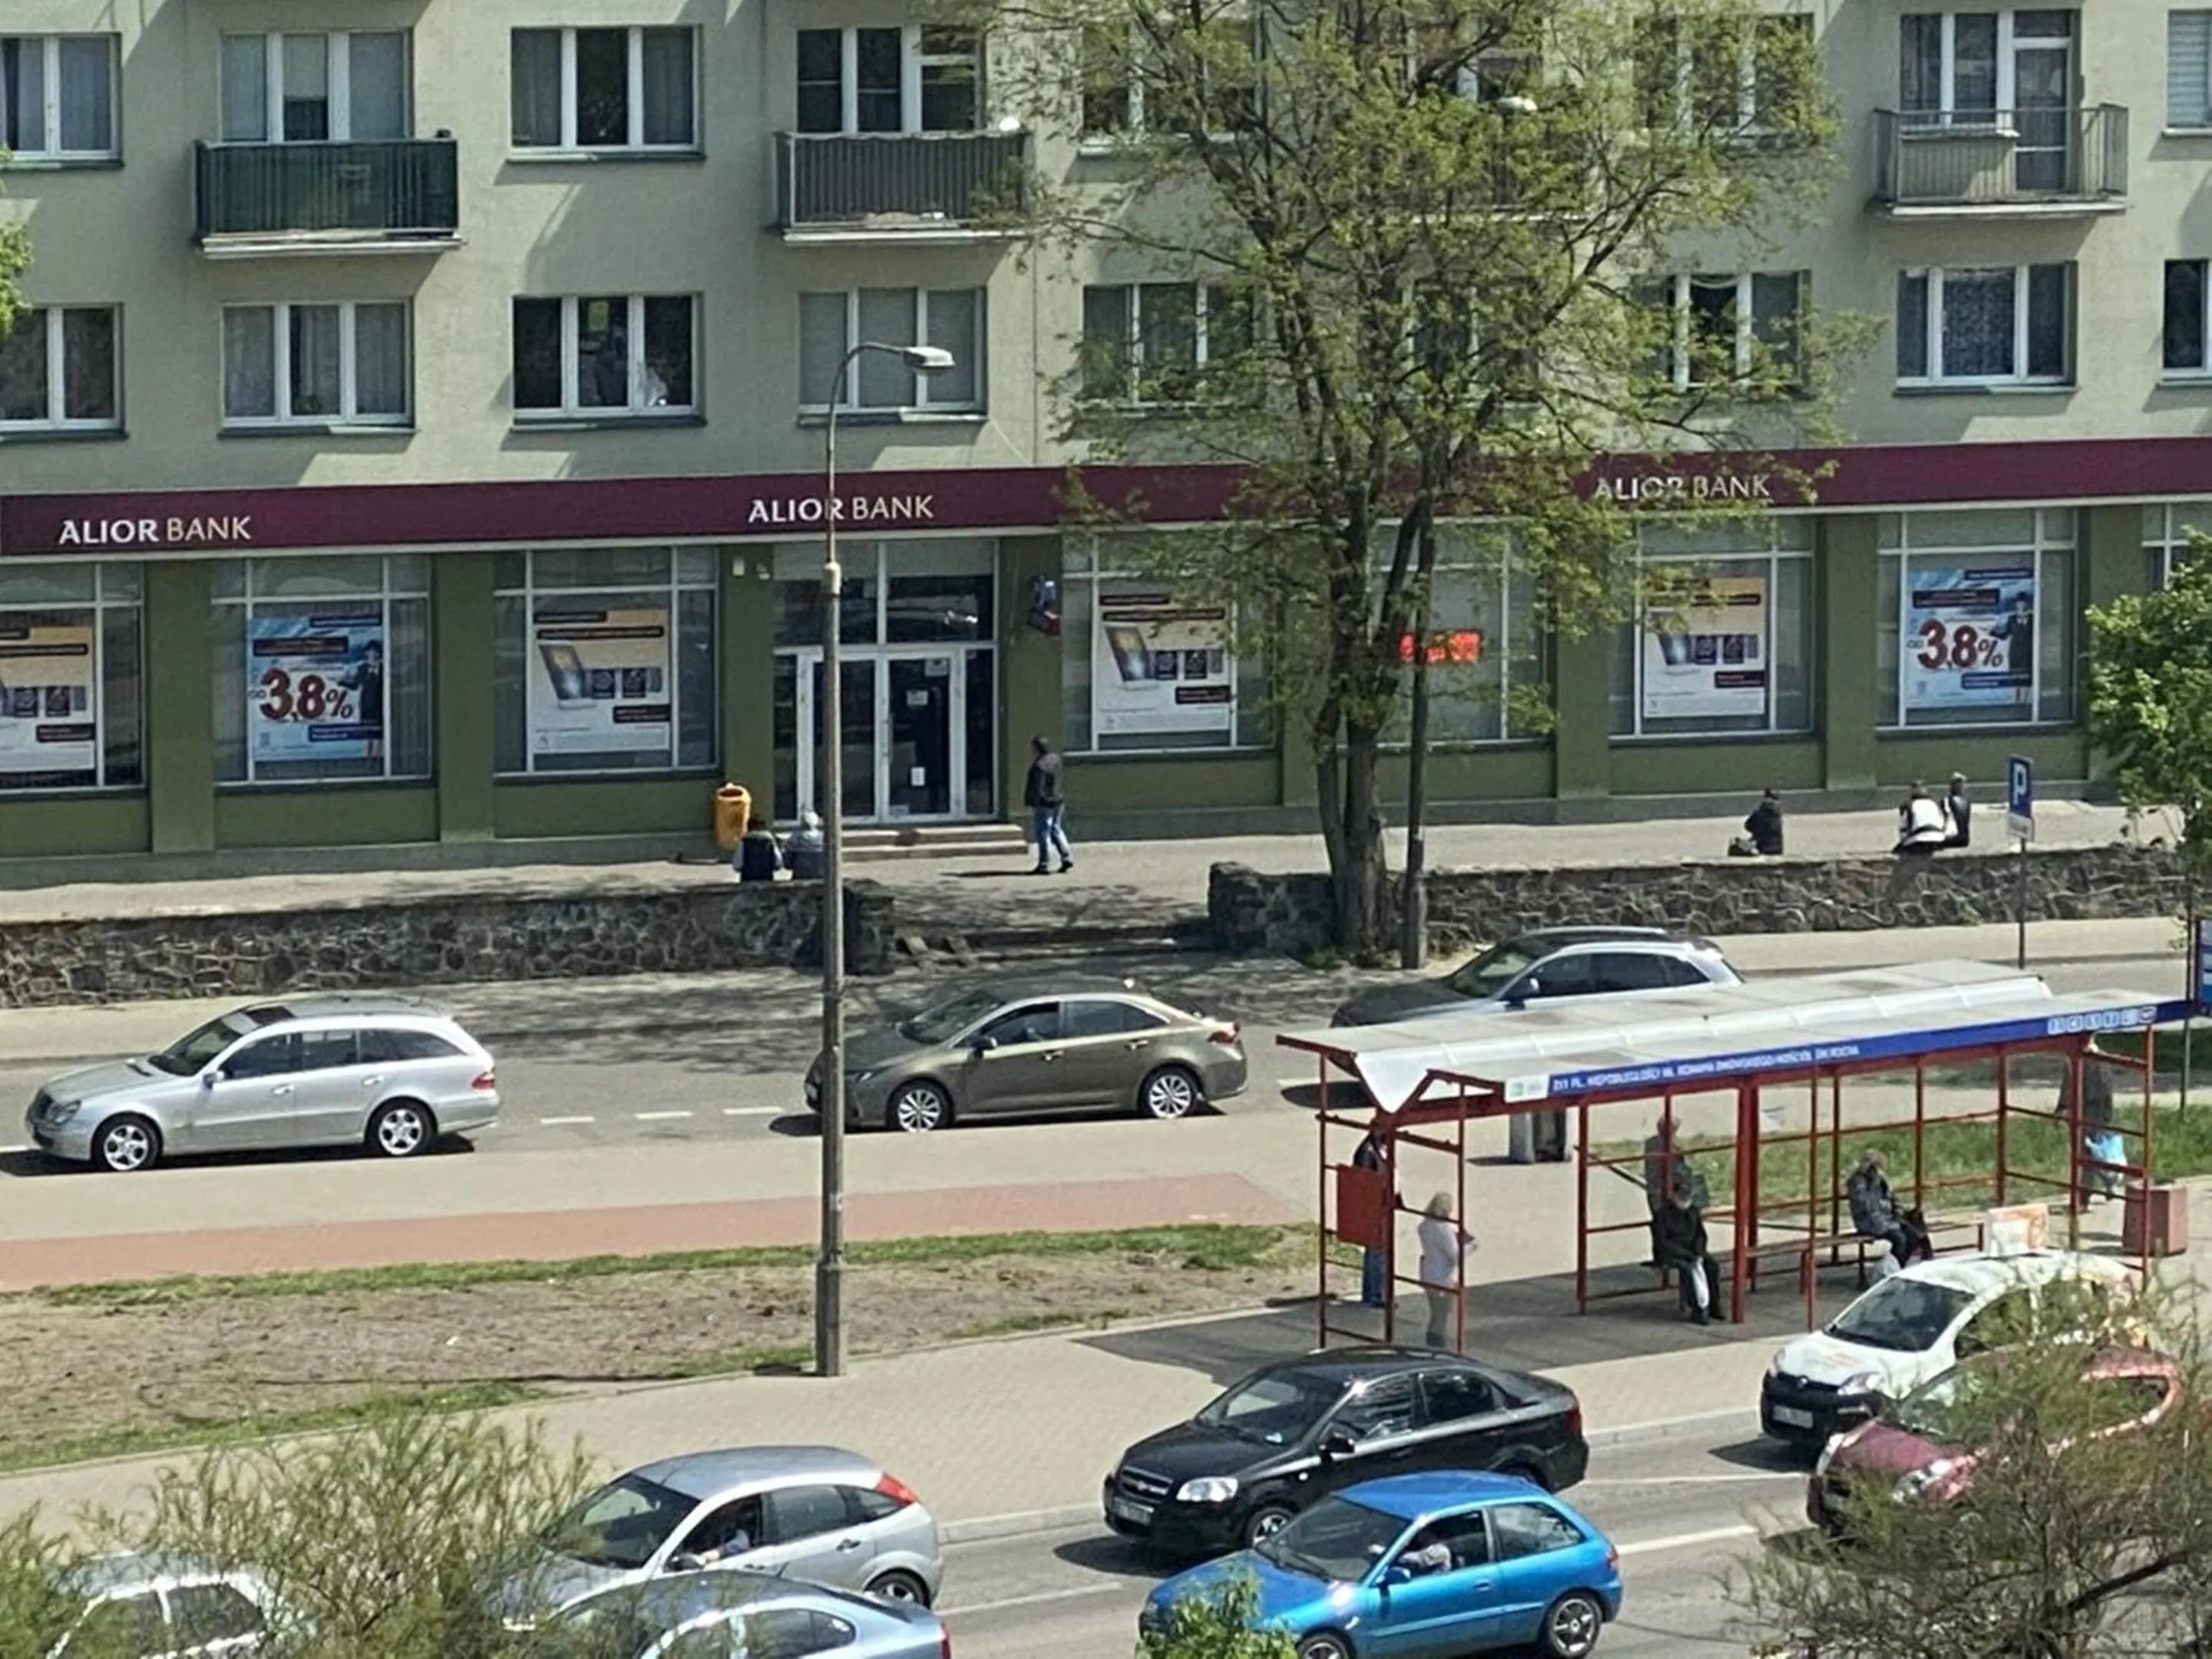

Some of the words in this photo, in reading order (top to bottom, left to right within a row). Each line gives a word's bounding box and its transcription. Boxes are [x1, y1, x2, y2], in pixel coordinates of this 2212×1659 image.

[1594, 476, 1687, 500] ALIOR
[1692, 474, 1770, 499] BANK
[747, 498, 845, 523] ALIOR
[852, 495, 934, 520] BANK
[58, 519, 160, 545] ALIOR
[166, 516, 252, 541] BANK
[2013, 763, 2028, 806] P
